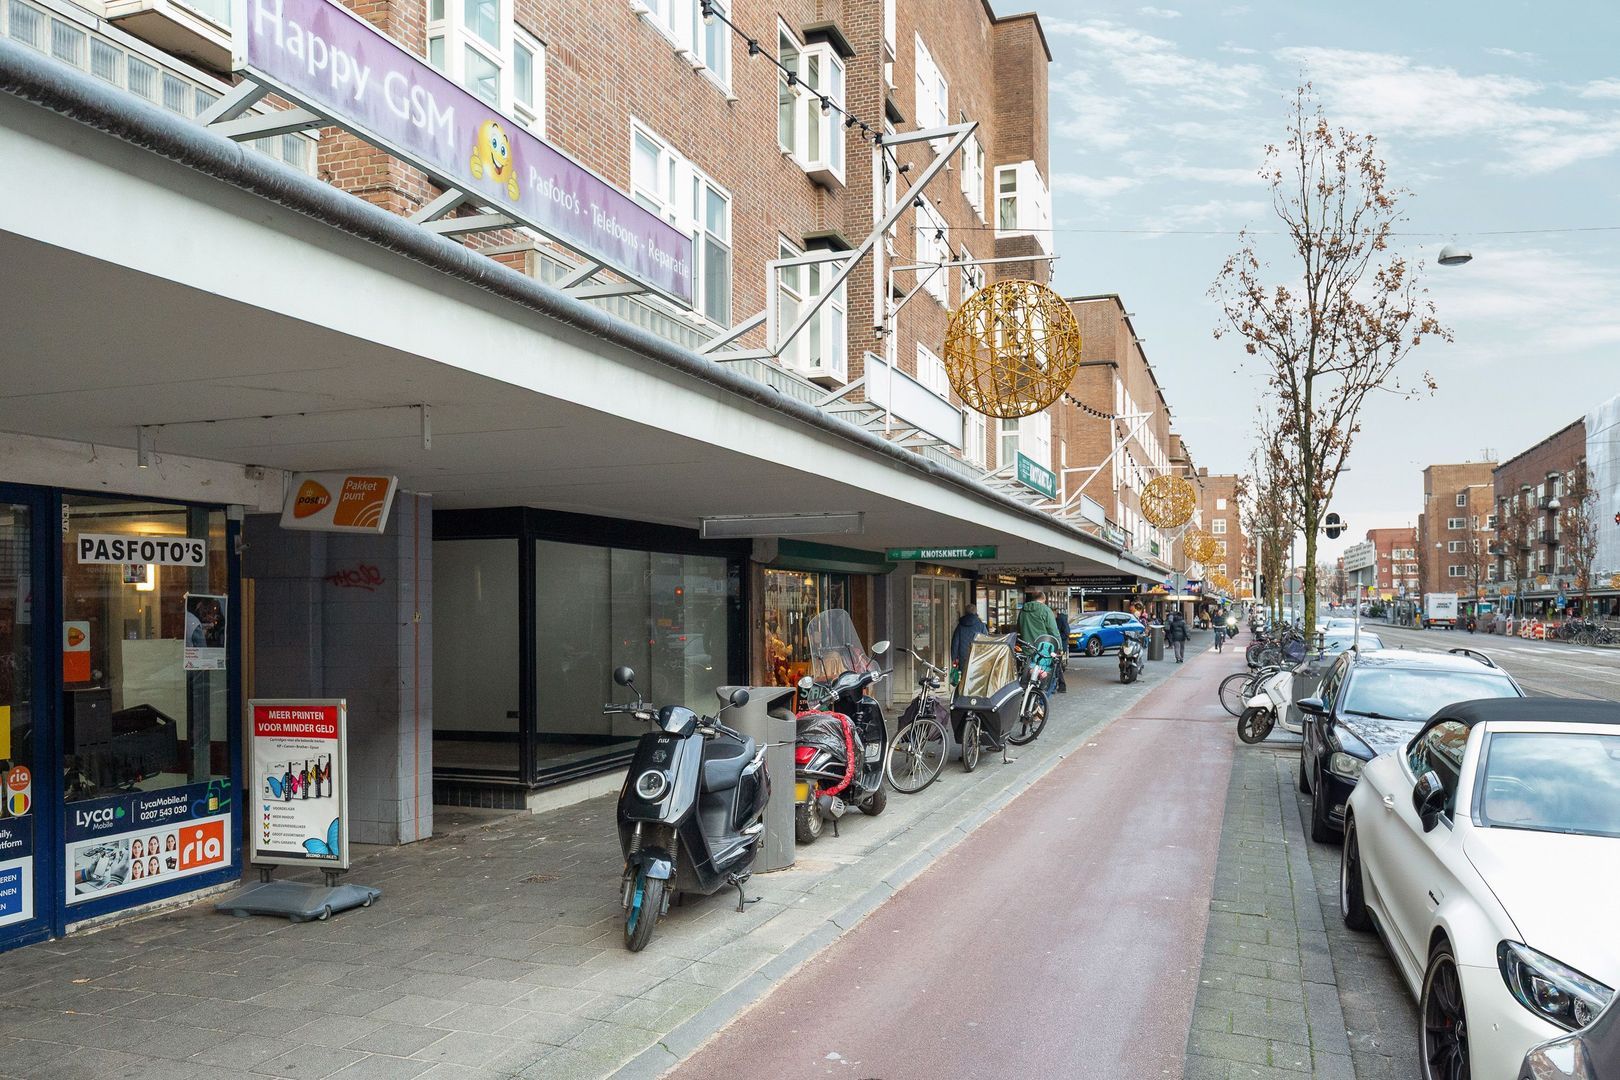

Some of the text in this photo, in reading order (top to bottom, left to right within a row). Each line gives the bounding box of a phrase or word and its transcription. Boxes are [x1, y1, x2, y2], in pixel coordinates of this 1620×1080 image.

[254, 0, 455, 148] Happy GSM
[530, 165, 580, 215] Pasfoto's
[590, 203, 638, 249] Telefoons
[648, 238, 689, 278] Reparatie
[346, 480, 378, 491] Pakket
[298, 496, 328, 504] postnl
[342, 492, 366, 502] punt
[80, 538, 204, 563] PASFOTO'S
[800, 687, 828, 698] SAL
[269, 711, 324, 720] MEER PRINTEN
[258, 723, 334, 733] VOOR MINDER GELD
[10, 769, 28, 782] ria
[140, 794, 188, 811] LycaMobile.nl
[76, 806, 114, 827] Lyca
[140, 810, 157, 820] 0207
[159, 808, 172, 818] 543
[174, 805, 187, 814] 030
[93, 822, 113, 830] Mobile
[182, 830, 220, 865] ria
